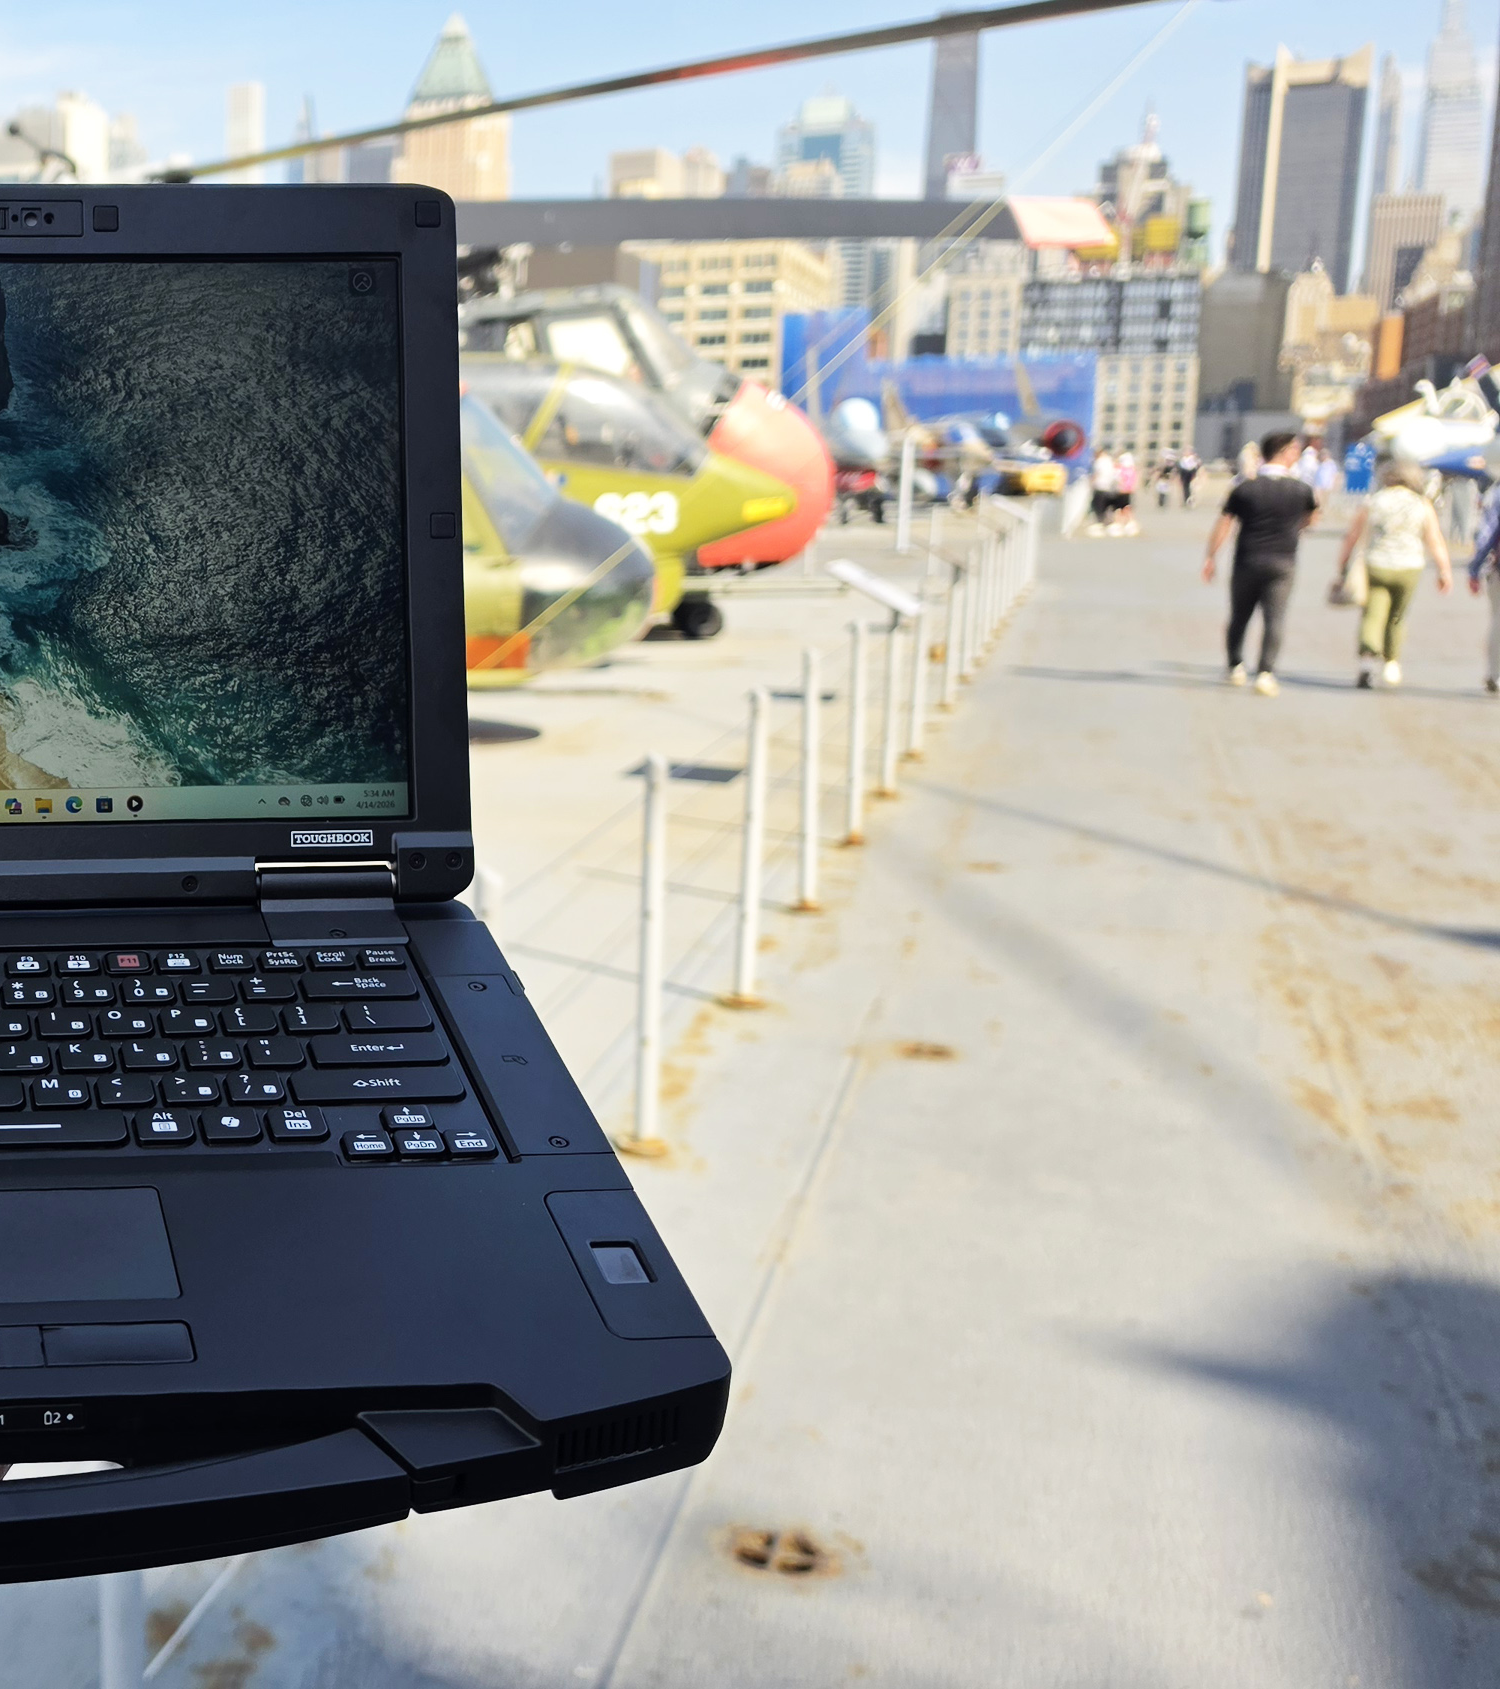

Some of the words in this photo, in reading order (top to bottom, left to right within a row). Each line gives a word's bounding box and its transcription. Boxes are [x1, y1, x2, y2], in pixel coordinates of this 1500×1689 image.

[294, 833, 370, 844] TOUGHBOOK
[13, 990, 24, 999] 8
[74, 989, 84, 998] 9
[133, 988, 145, 997] 0
[107, 1010, 122, 1019] O
[170, 1009, 181, 1018] P
[8, 1046, 16, 1055] J
[69, 1044, 81, 1053] K
[133, 1043, 144, 1052] L
[351, 1044, 385, 1052] Enter
[41, 1079, 59, 1089] M
[368, 1078, 401, 1087] Shift
[152, 1112, 174, 1120] Alt
[283, 1110, 307, 1118] Del
